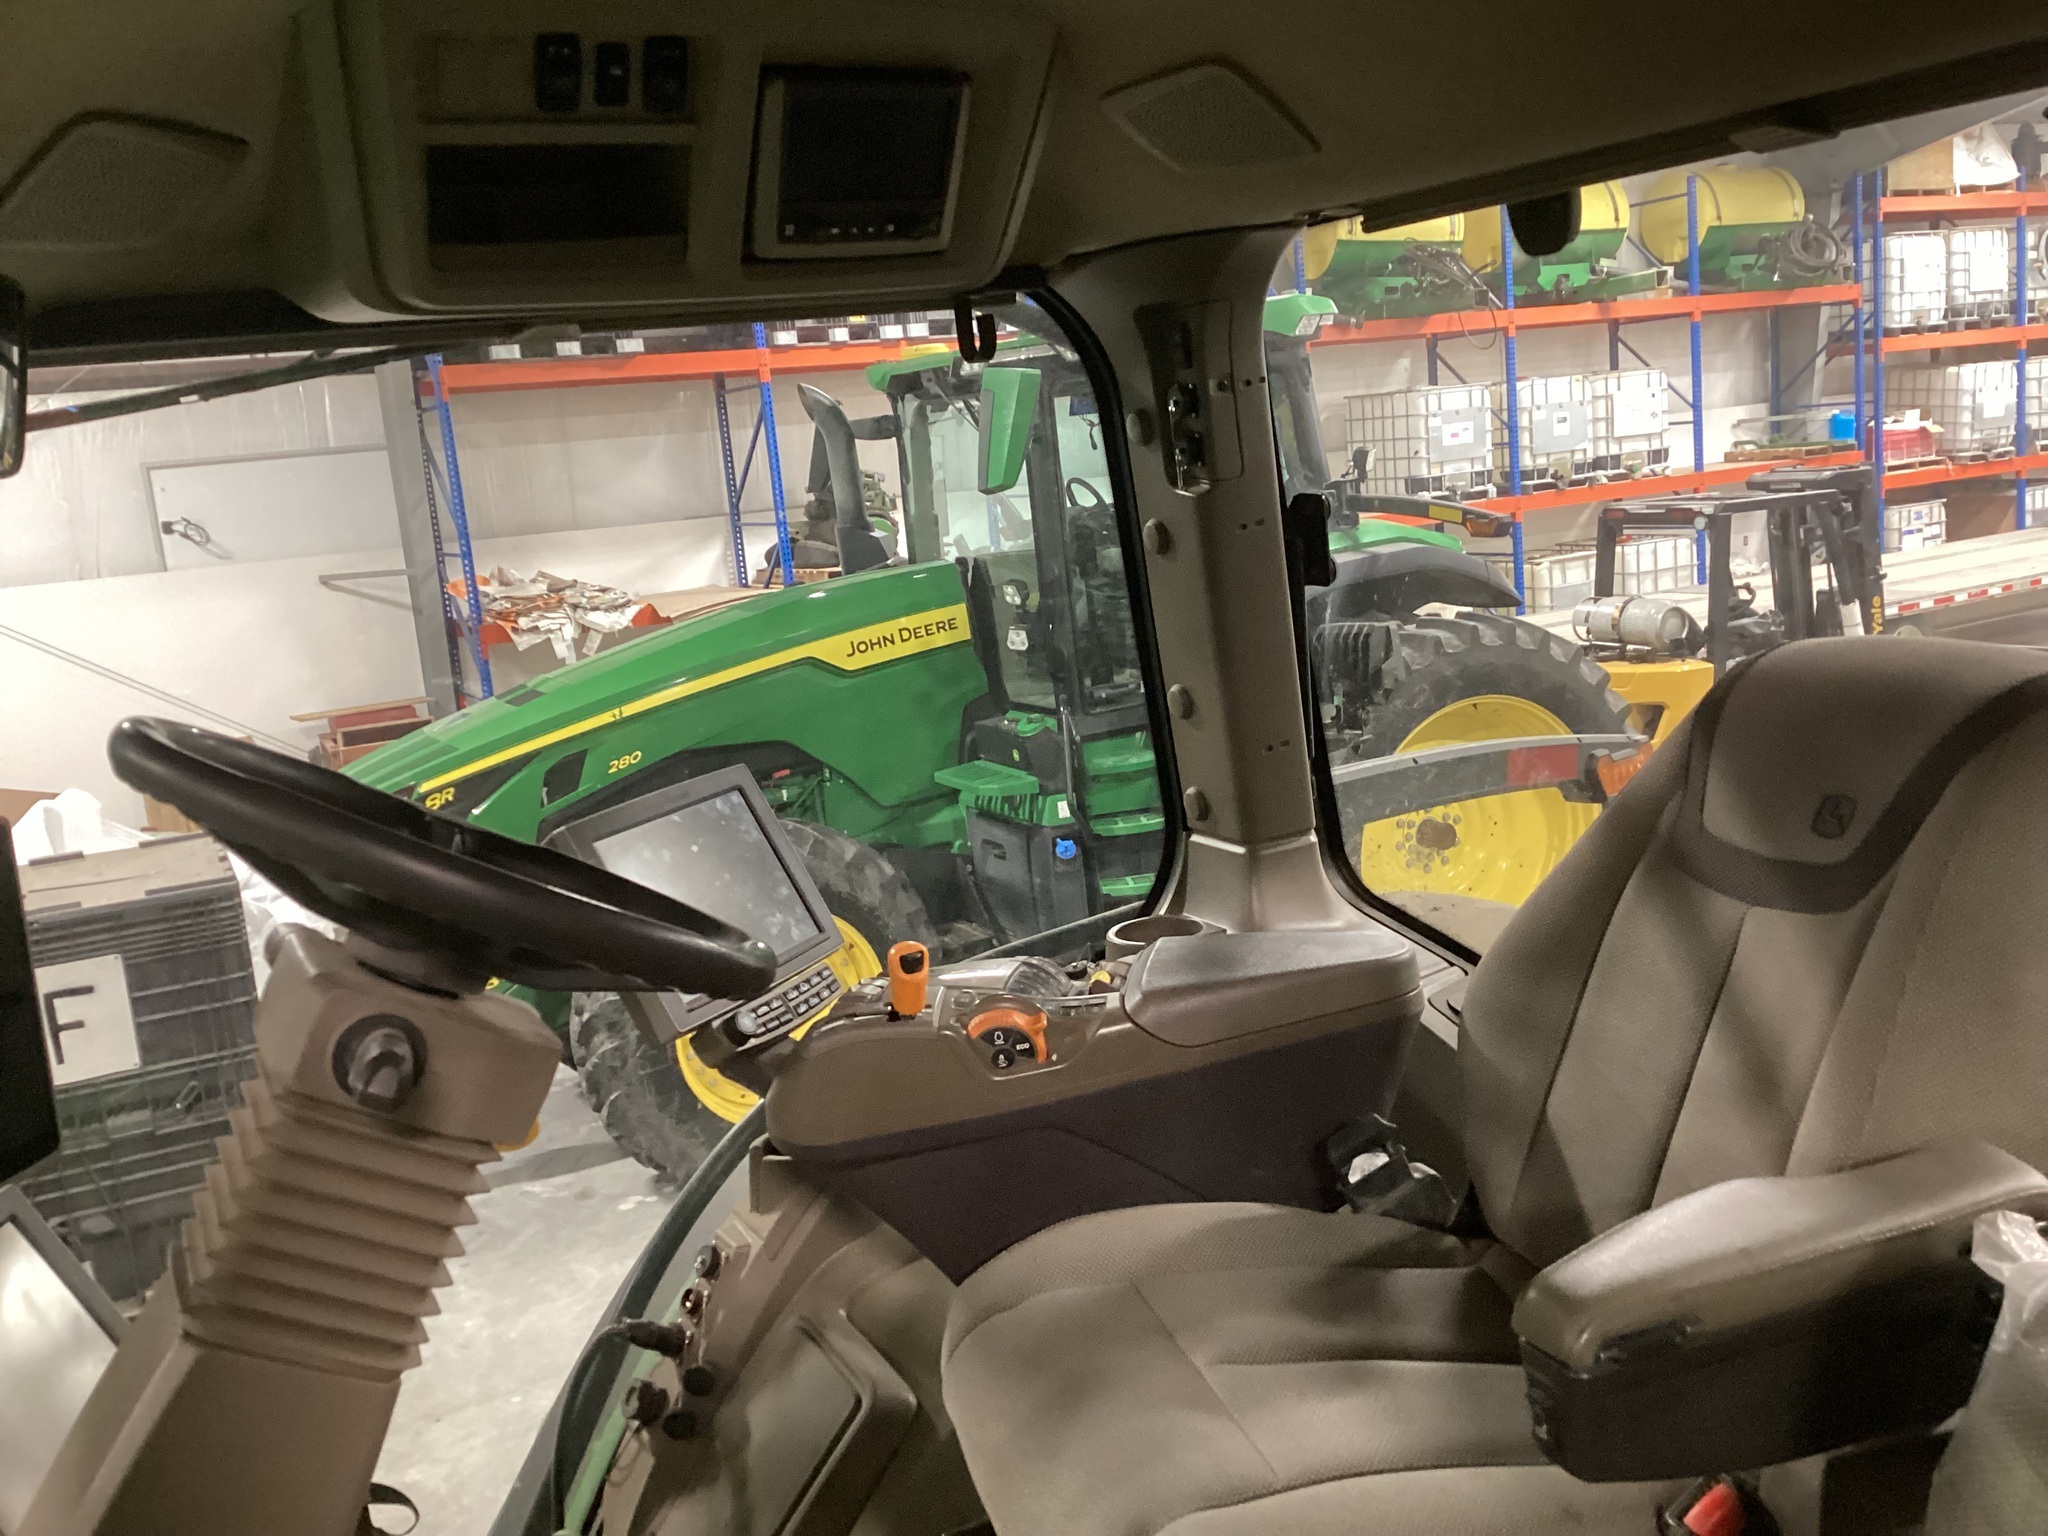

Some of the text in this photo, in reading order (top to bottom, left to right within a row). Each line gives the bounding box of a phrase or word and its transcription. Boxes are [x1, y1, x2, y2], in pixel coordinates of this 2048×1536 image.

[1870, 595, 1883, 636] Yale
[846, 617, 959, 658] JOHN DEERE
[607, 750, 643, 775] 280
[424, 786, 455, 811] 8R
[43, 985, 95, 1065] F
[1016, 1042, 1030, 1051] ECO
